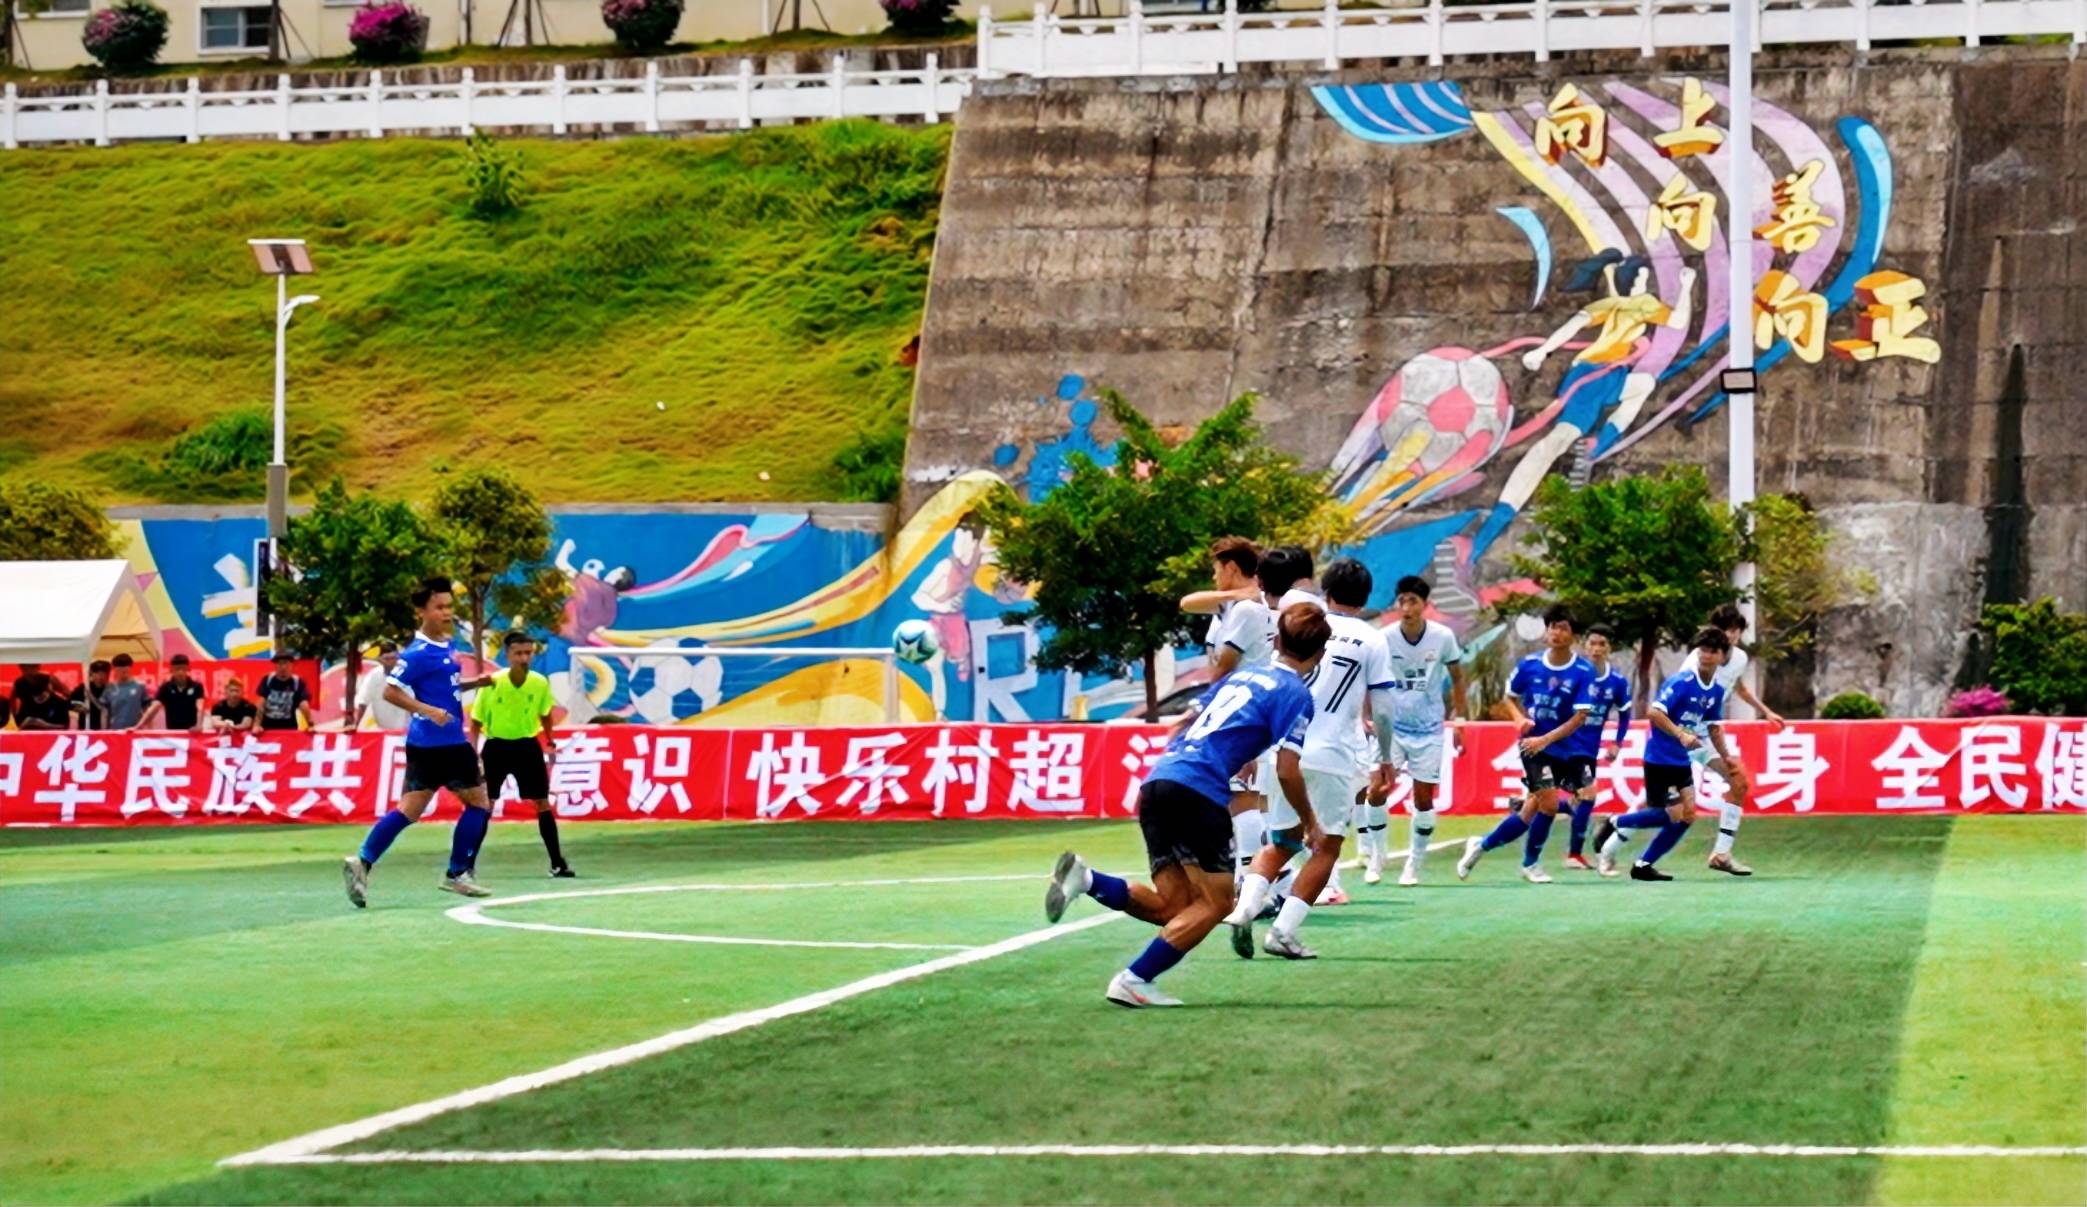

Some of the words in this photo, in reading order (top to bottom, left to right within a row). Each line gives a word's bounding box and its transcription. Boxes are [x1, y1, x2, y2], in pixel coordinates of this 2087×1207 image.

[1535, 76, 1725, 167] 向上
[1646, 159, 1836, 254] 向善
[1754, 269, 1941, 364] 向正
[0, 732, 692, 822] 华民族共意识
[746, 728, 1086, 818] 快乐村超
[1871, 722, 2087, 811] 全民健
